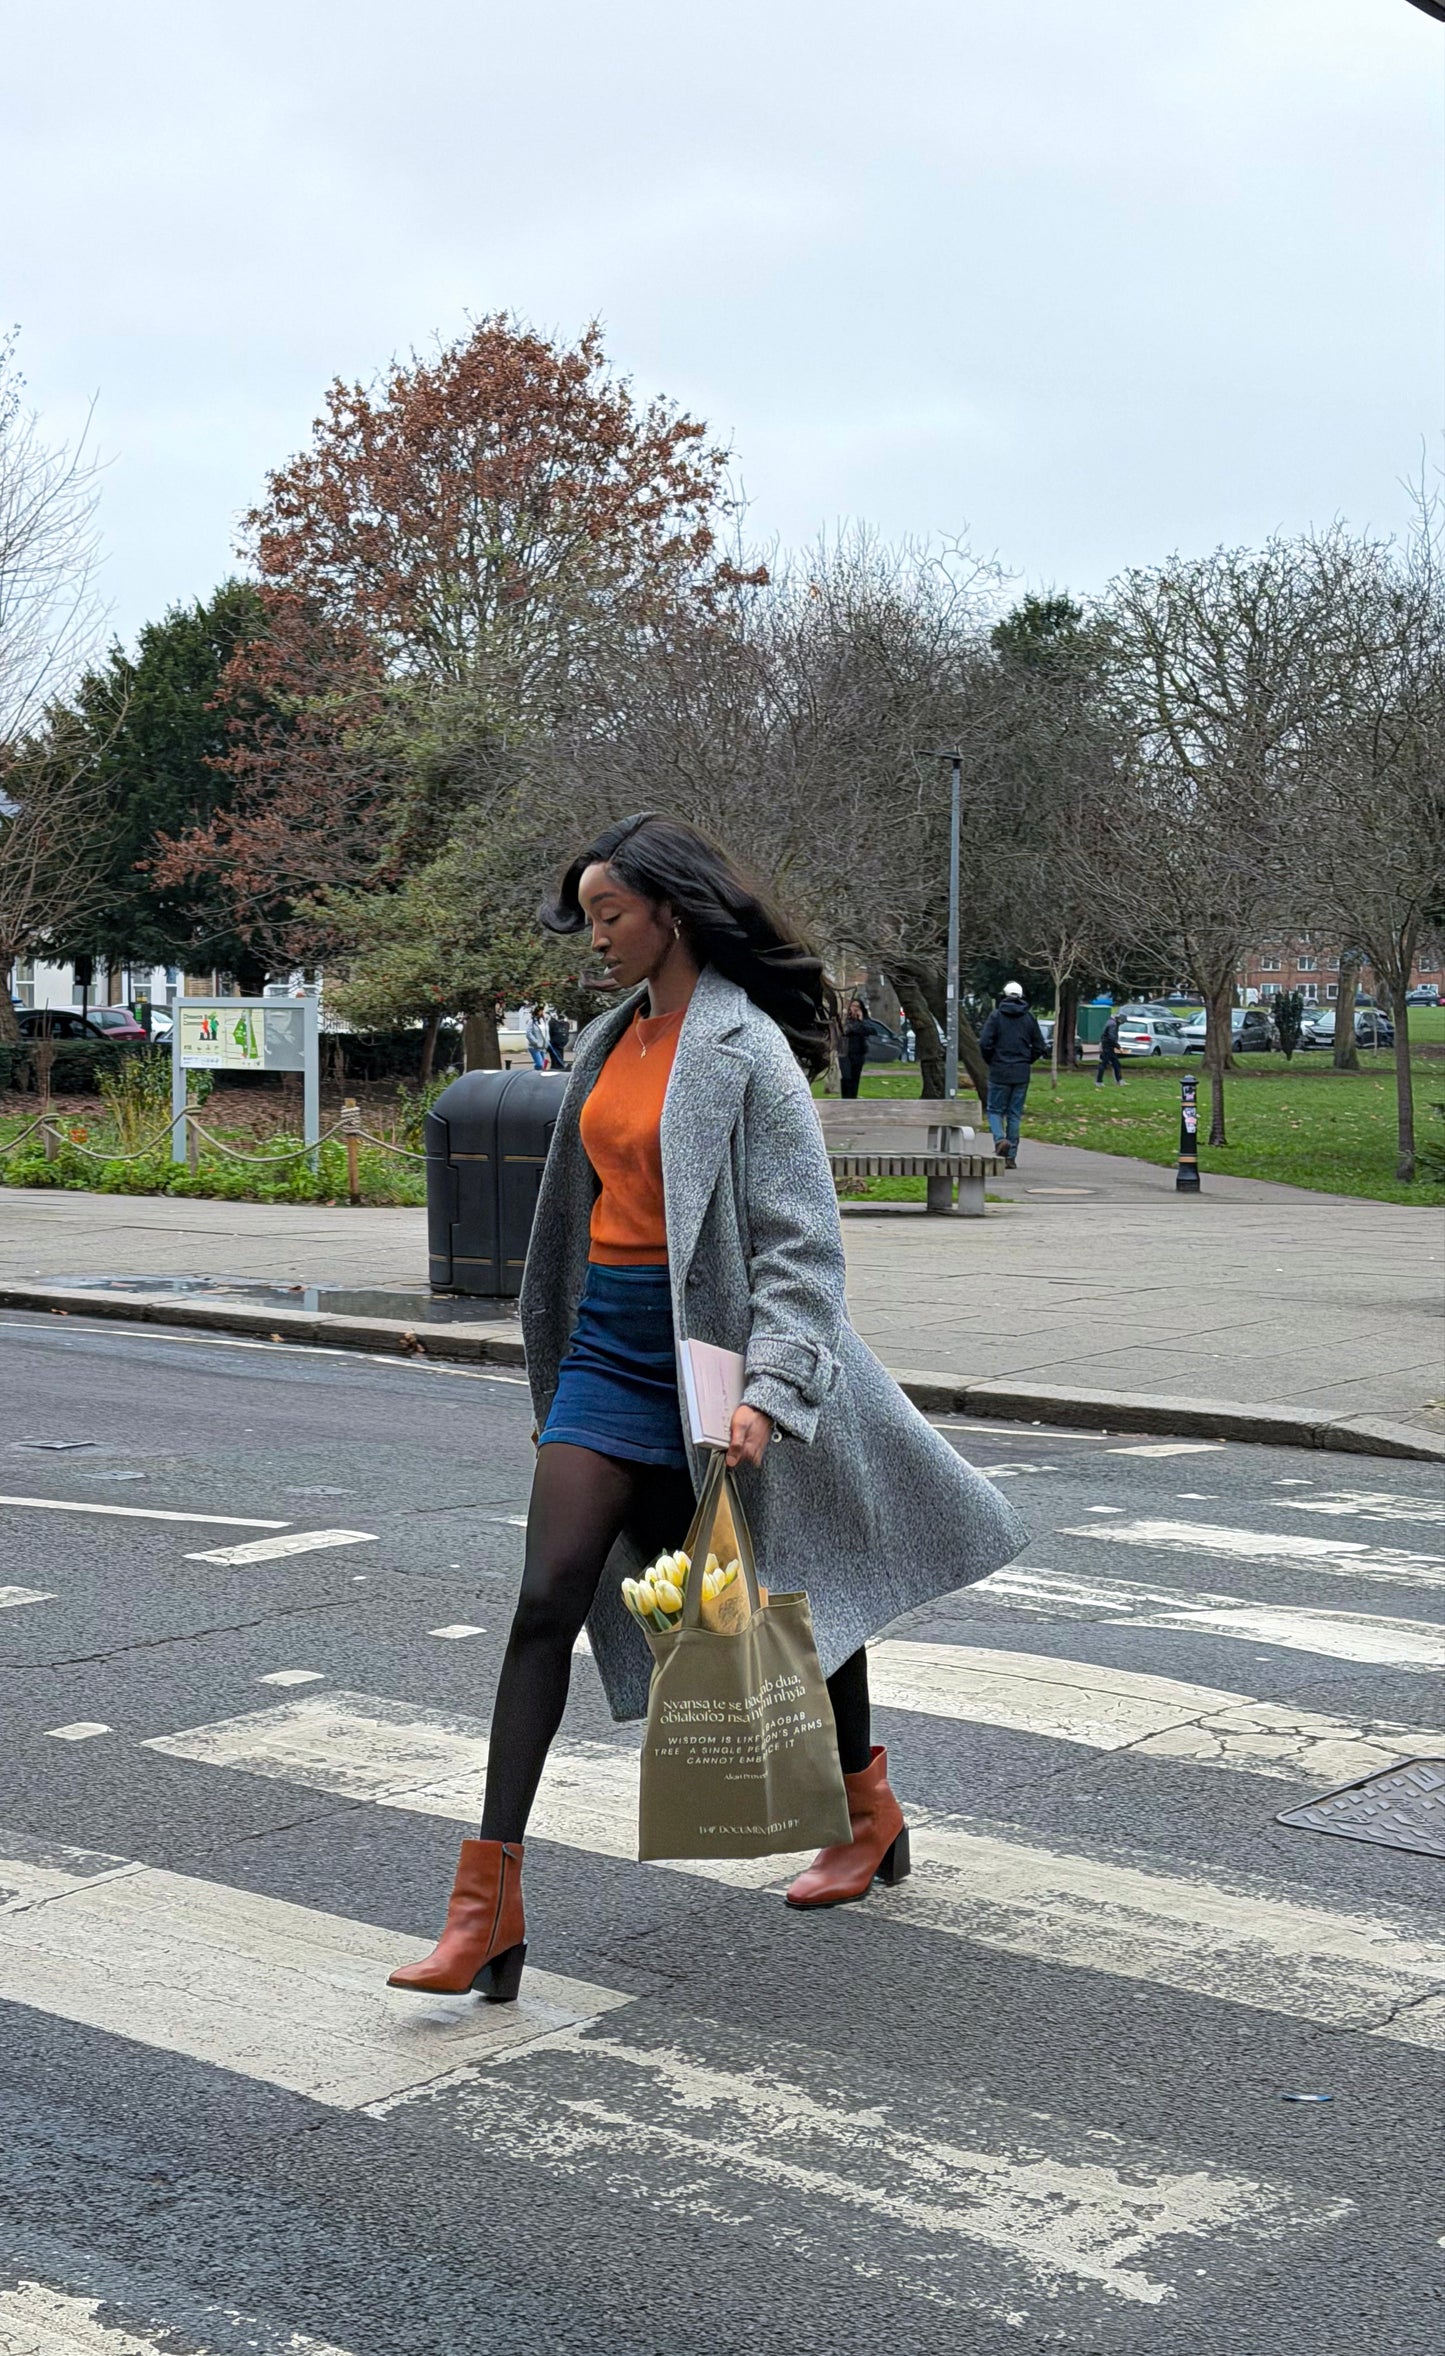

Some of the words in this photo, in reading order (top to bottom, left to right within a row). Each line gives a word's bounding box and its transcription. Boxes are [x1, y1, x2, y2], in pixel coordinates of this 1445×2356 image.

[654, 1747, 680, 1757] TREE
[689, 1746, 696, 1755] A
[701, 1746, 742, 1755] SINGLE
[747, 1728, 789, 1754] PEON'S
[793, 1718, 823, 1736] ARMS
[667, 1736, 716, 1746] WISDOM
[721, 1736, 732, 1744] IS
[765, 1711, 806, 1733] BAOBAB
[686, 1756, 735, 1765] CANNOT
[739, 1742, 780, 1765] EMBCE
[785, 1738, 795, 1749] IT
